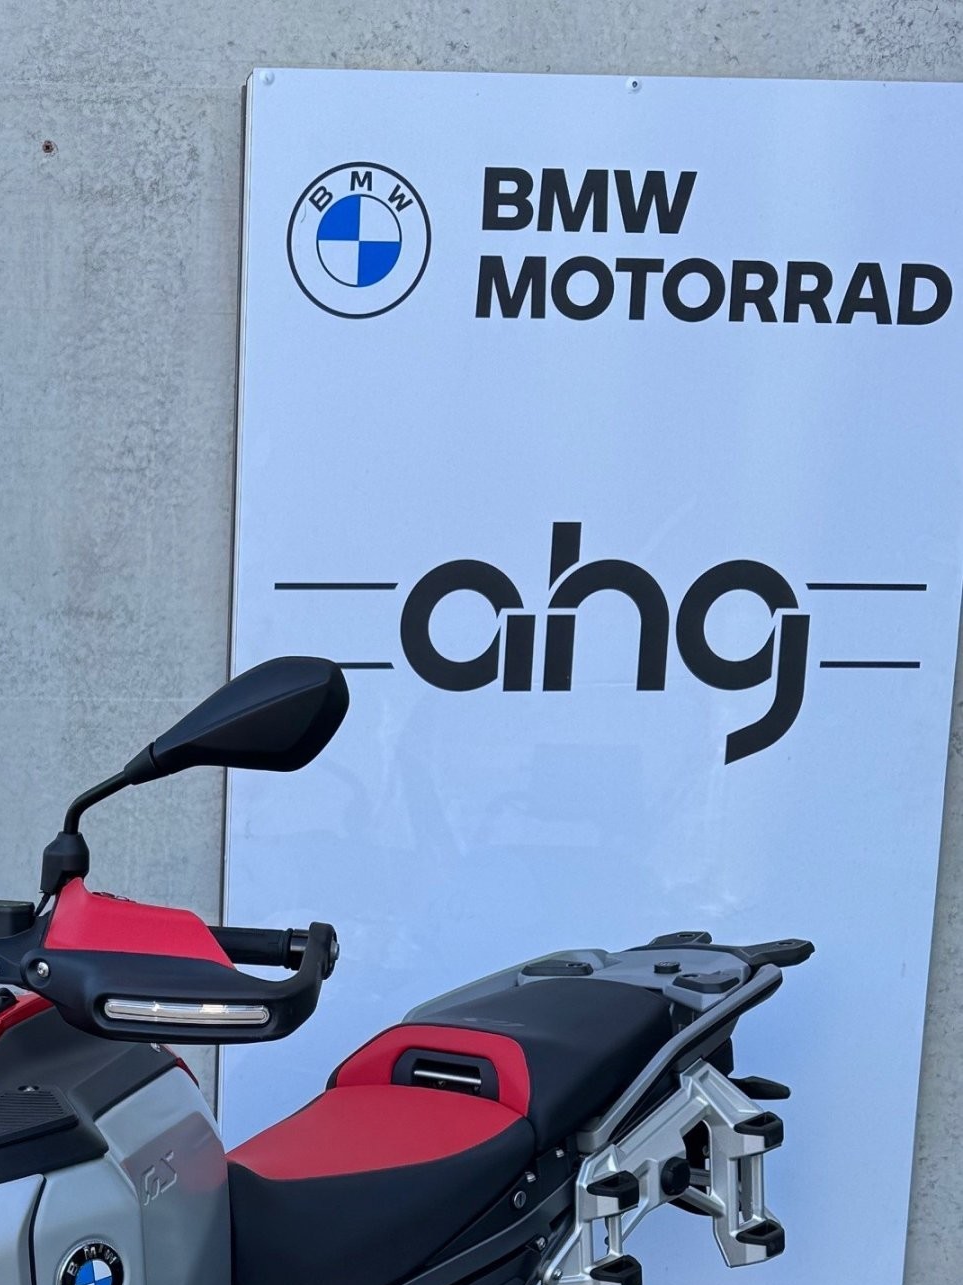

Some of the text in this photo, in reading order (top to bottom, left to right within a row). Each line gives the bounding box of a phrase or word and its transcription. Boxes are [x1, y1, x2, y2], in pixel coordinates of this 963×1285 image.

[308, 171, 414, 212] BMW
[482, 167, 697, 234] BMW
[475, 255, 953, 325] MOTORRAD
[400, 522, 810, 764] ahg
[66, 1245, 117, 1277] BMW
